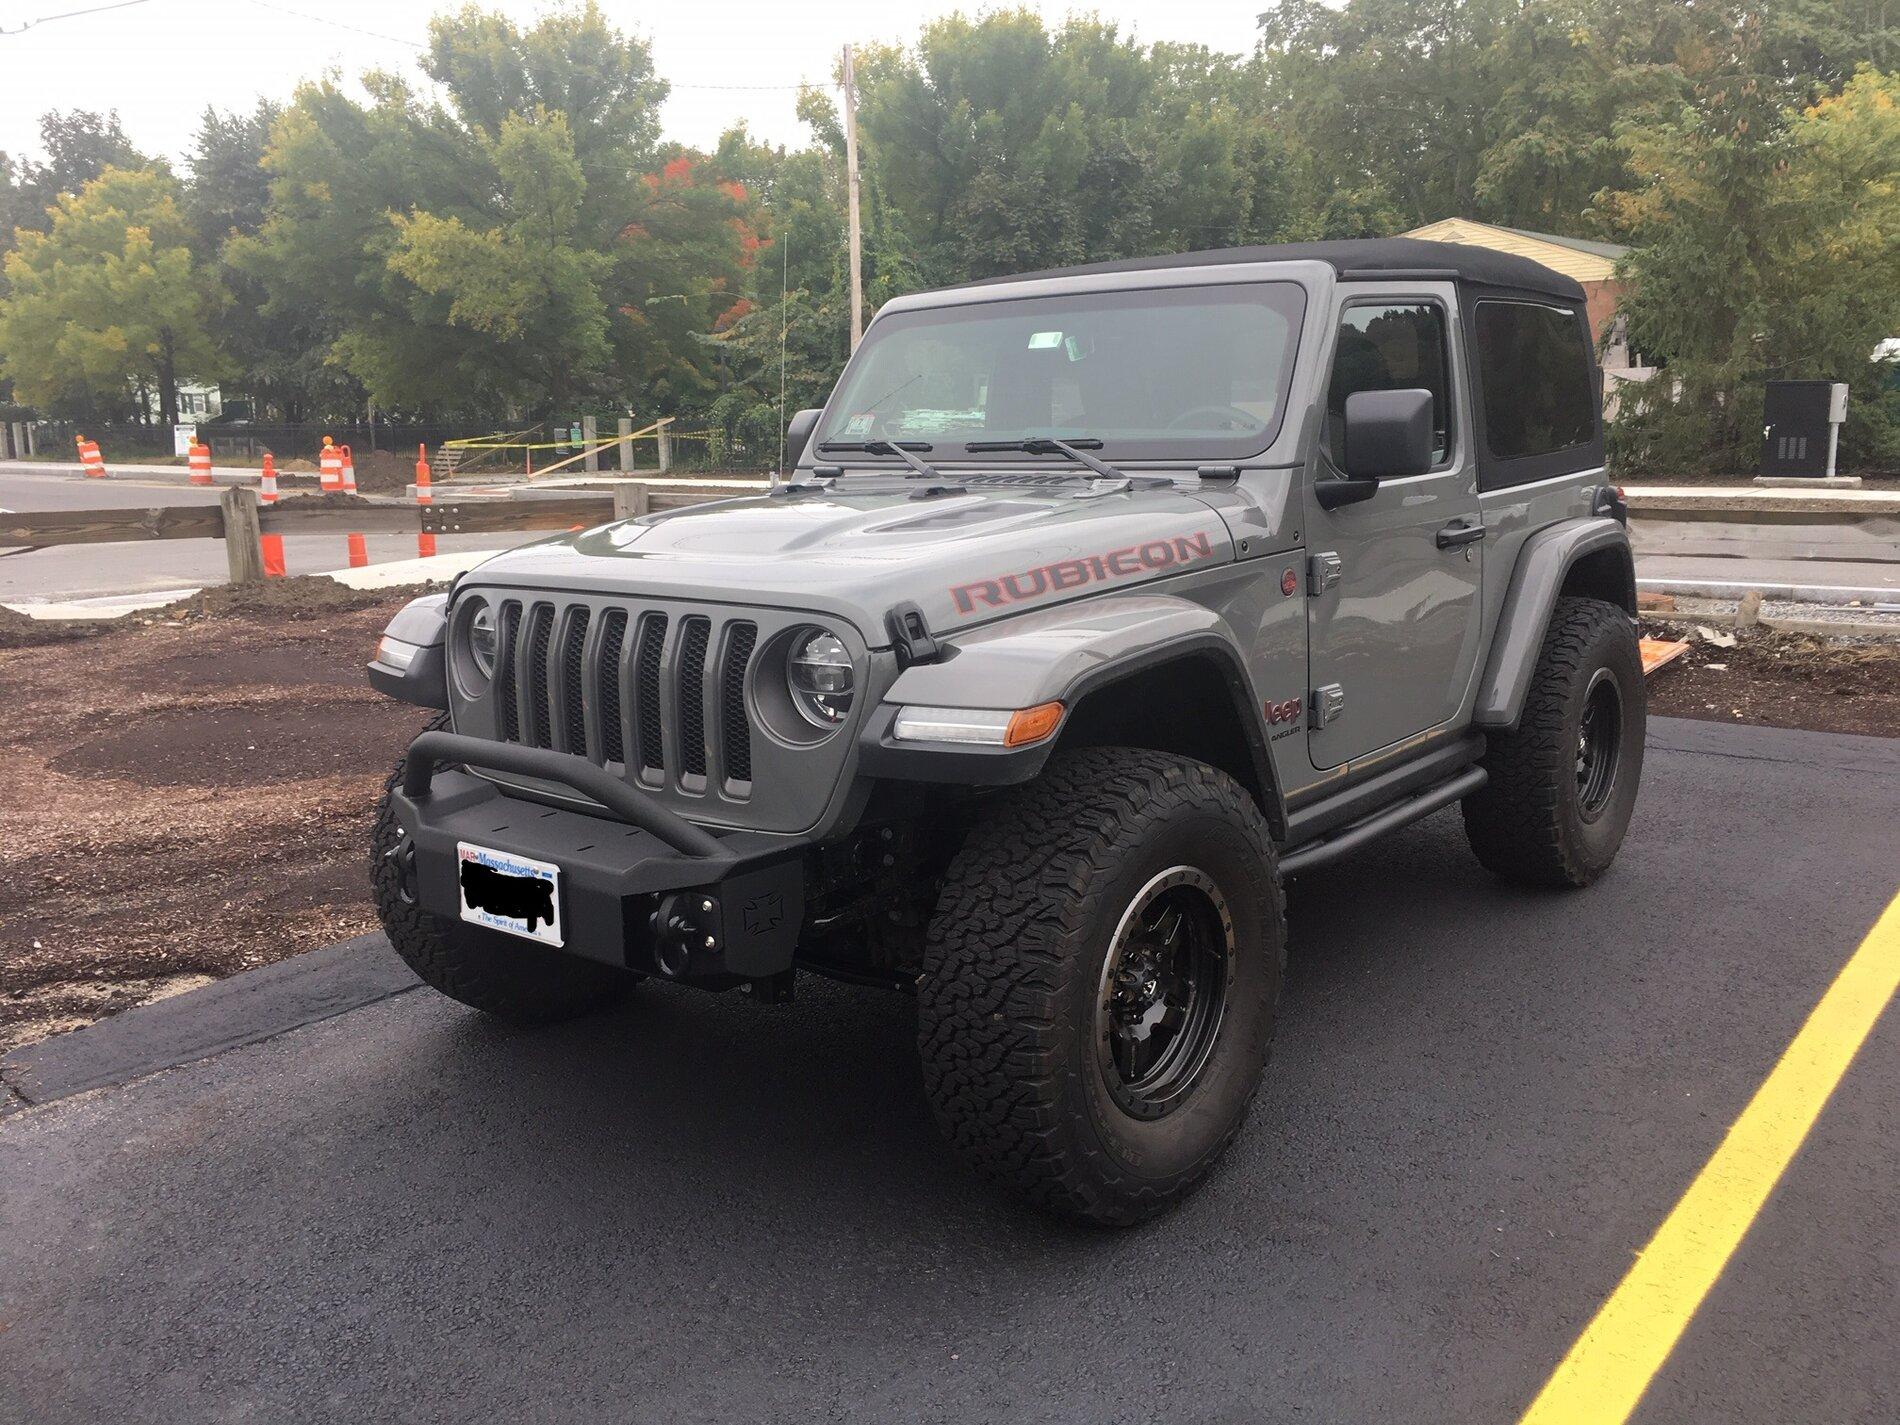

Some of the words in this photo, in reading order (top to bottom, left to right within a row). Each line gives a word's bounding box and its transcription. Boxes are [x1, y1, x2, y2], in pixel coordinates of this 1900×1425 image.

[950, 532, 1214, 616] RUBICON
[1264, 697, 1301, 726] Jeep
[1271, 726, 1301, 742] ANGLER
[479, 853, 535, 877] Massachusetts
[482, 912, 492, 922] The
[494, 916, 507, 926] Spirit
